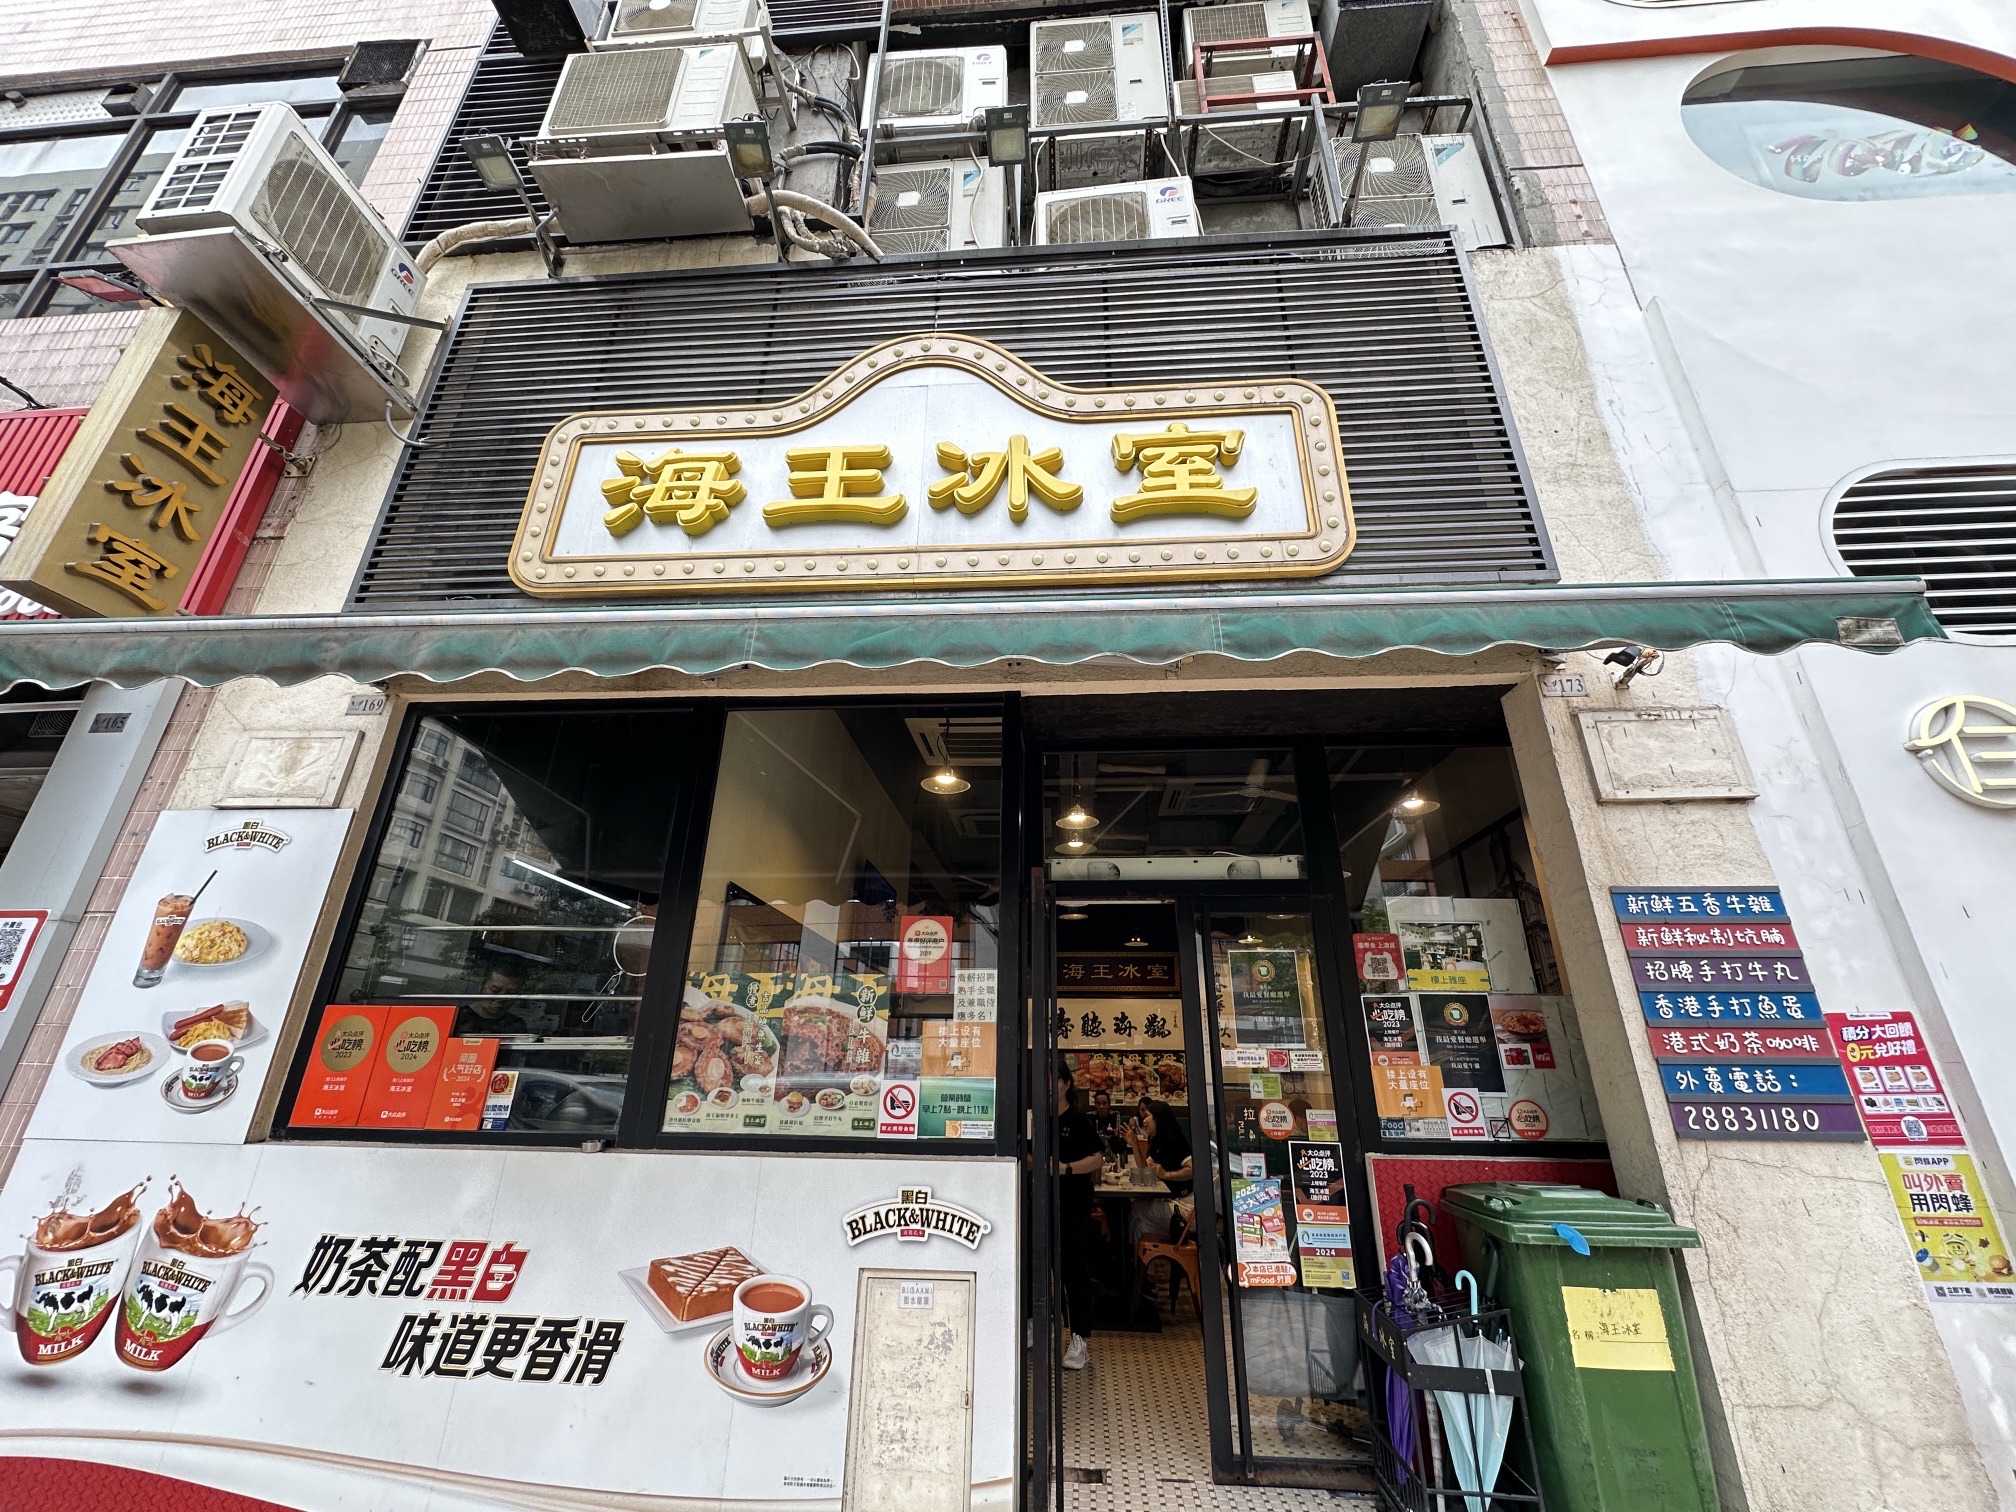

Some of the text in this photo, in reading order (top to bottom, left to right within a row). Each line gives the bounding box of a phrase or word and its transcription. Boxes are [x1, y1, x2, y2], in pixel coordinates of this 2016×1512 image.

[1155, 196, 1184, 204] GREE
[391, 267, 415, 297] GREE
[64, 343, 263, 611] 海王冰室
[600, 423, 1259, 537] 海王冰室
[1559, 678, 1584, 693] 173
[362, 698, 384, 712] 169
[104, 716, 127, 730] 165
[206, 830, 285, 850] BLACK&WHITE
[1626, 892, 1775, 916] 新鮮五香牛雜
[1636, 926, 1786, 947] 新鮮秘制坑腩
[1062, 963, 1169, 980] 海王冰室
[1645, 959, 1799, 983] 招牌手打牛丸
[957, 985, 995, 996] 熟手全職
[1654, 993, 1805, 1019] 香港手打魚蛋
[1370, 1009, 1406, 1021] 必吃榜
[1841, 1022, 1915, 1041] 積分大回饋
[328, 1038, 364, 1051] 必吃榜
[395, 1040, 430, 1053] 必吃榜
[1663, 1031, 1820, 1055] 港式奶茶咖啡
[334, 1051, 353, 1059] 2023
[448, 1064, 483, 1074] 人气好店
[1388, 1080, 1430, 1090] 大量座位
[1243, 1107, 1256, 1120] 拉
[1684, 1105, 1820, 1132] 28831180
[1381, 1120, 1404, 1129] Food
[1297, 1157, 1335, 1171] 必吃榜
[1309, 1171, 1329, 1179] 2023
[1902, 1174, 1964, 1193] 叫外賣
[901, 1189, 928, 1205] 黑白
[1909, 1193, 1974, 1213] 用閃蜂
[846, 1207, 982, 1244] BLACK&WHITE
[1315, 1248, 1336, 1256] 2024
[34, 1260, 115, 1287] BLACK&WHITE
[141, 1260, 213, 1293] BLACK&WHITE
[294, 1235, 529, 1303] 奶茶配黑白
[743, 1322, 796, 1332] BLACK&WHITE
[1598, 1321, 1643, 1336] 海王冰室
[38, 1333, 85, 1355] MILK
[124, 1338, 164, 1361] MILK
[380, 1311, 628, 1386] 味道更香滑
[751, 1367, 781, 1376] MILK
